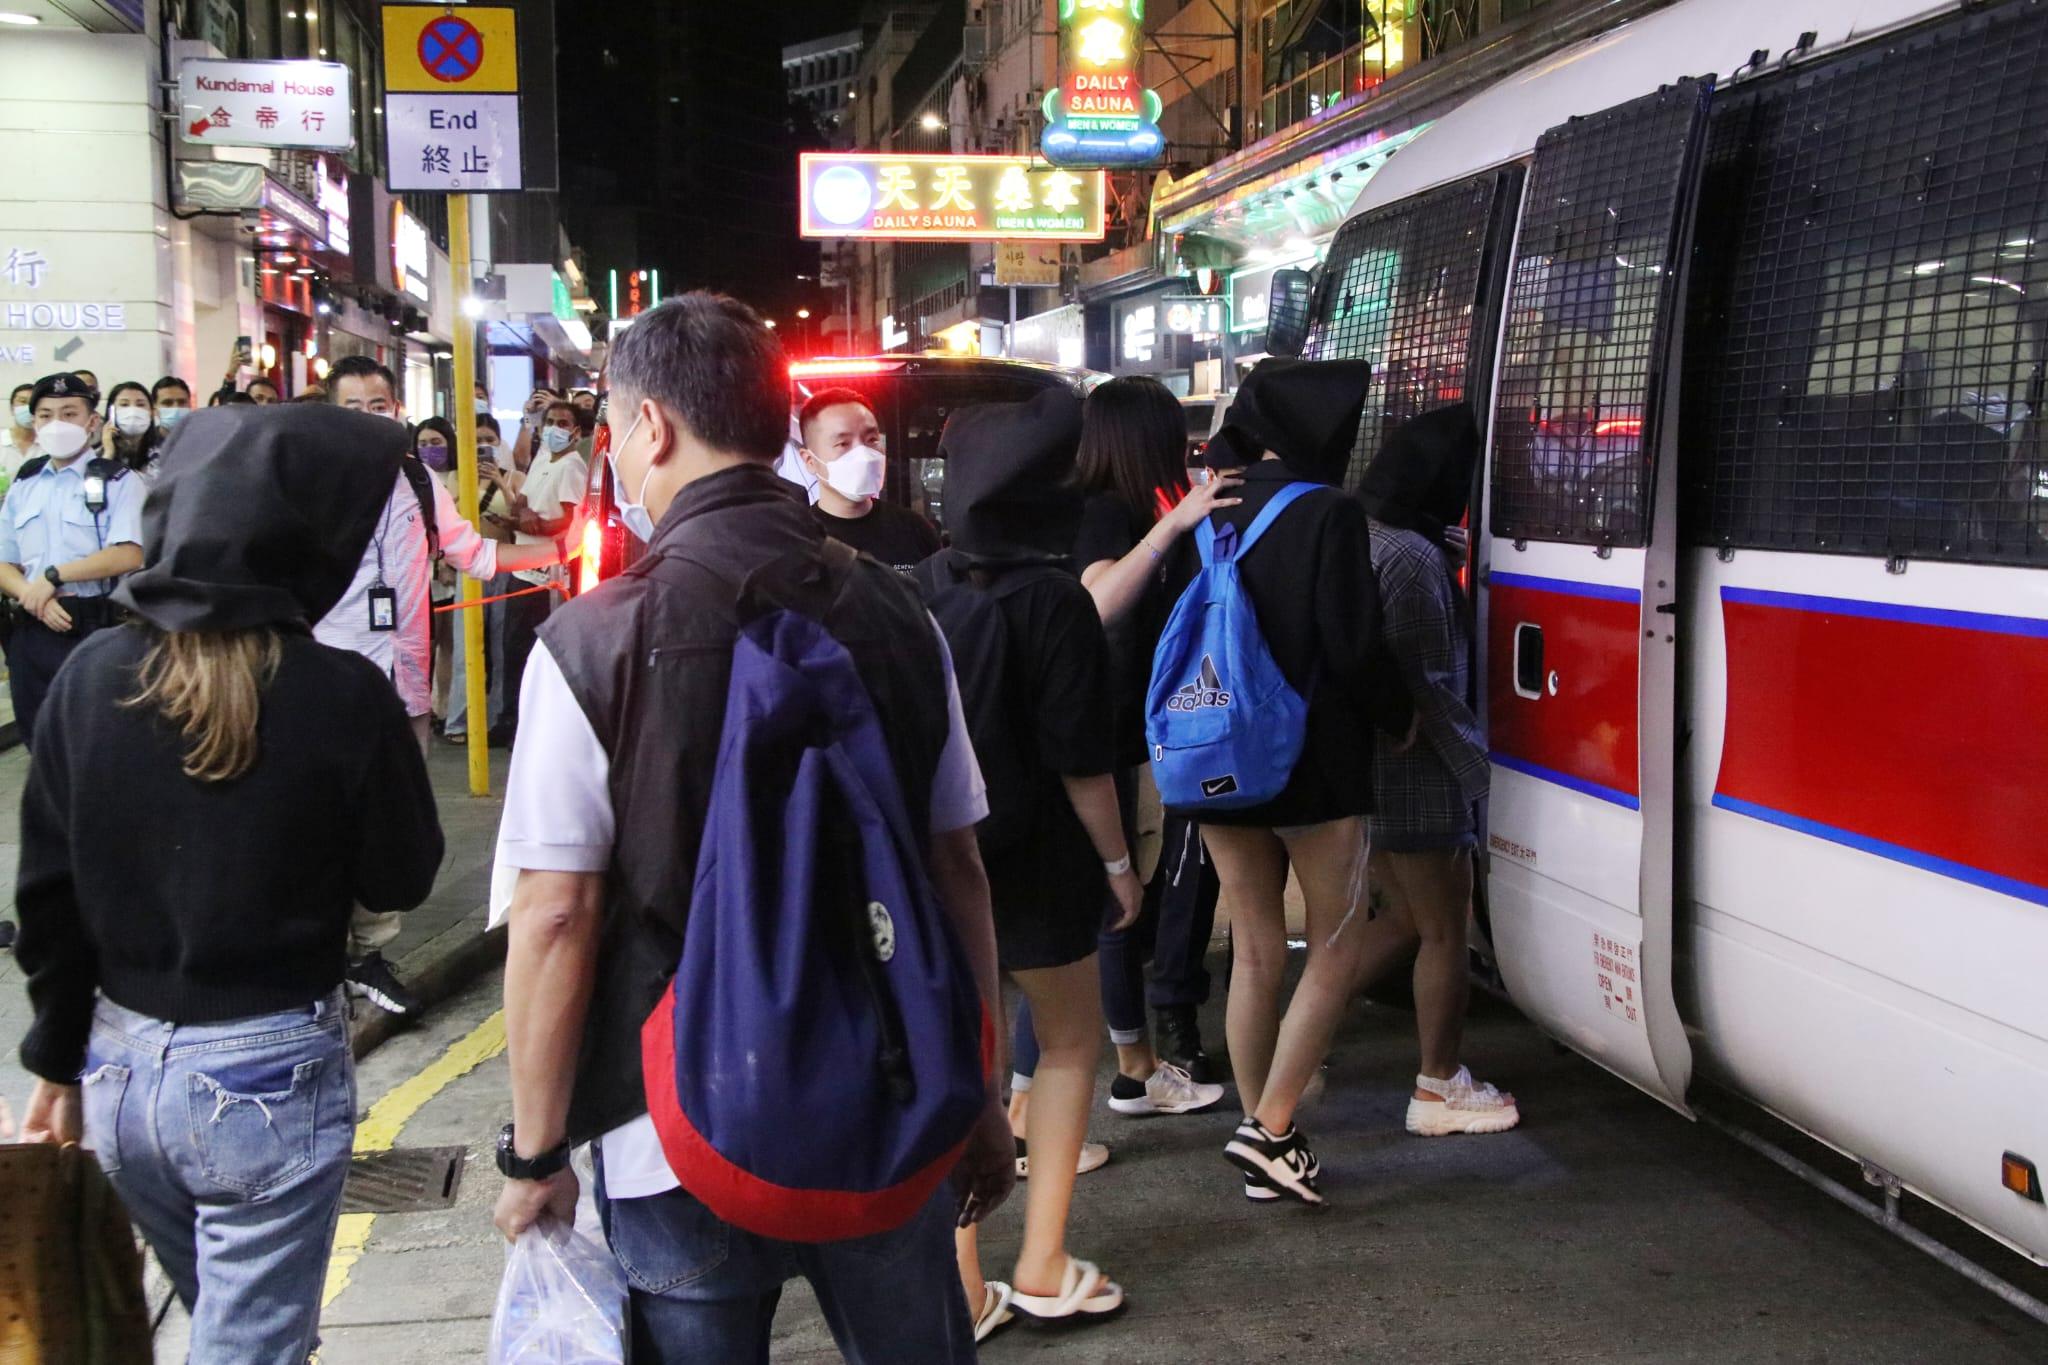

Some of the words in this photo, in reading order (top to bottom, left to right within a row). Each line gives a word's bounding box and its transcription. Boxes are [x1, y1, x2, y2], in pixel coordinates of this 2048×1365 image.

[195, 75, 275, 95] Kundamal
[284, 80, 335, 97] House
[1075, 75, 1129, 91] DAILY
[1071, 96, 1134, 112] SAUNA
[210, 105, 326, 132] 金帝行
[429, 109, 478, 130] End
[1067, 119, 1090, 131] MEN
[1100, 119, 1139, 131] WOMEN
[421, 144, 489, 174] 終止
[873, 214, 919, 228] DAILY
[922, 214, 977, 229] SAUNA
[7, 303, 123, 329] HOUSE
[1166, 688, 1231, 712] addas
